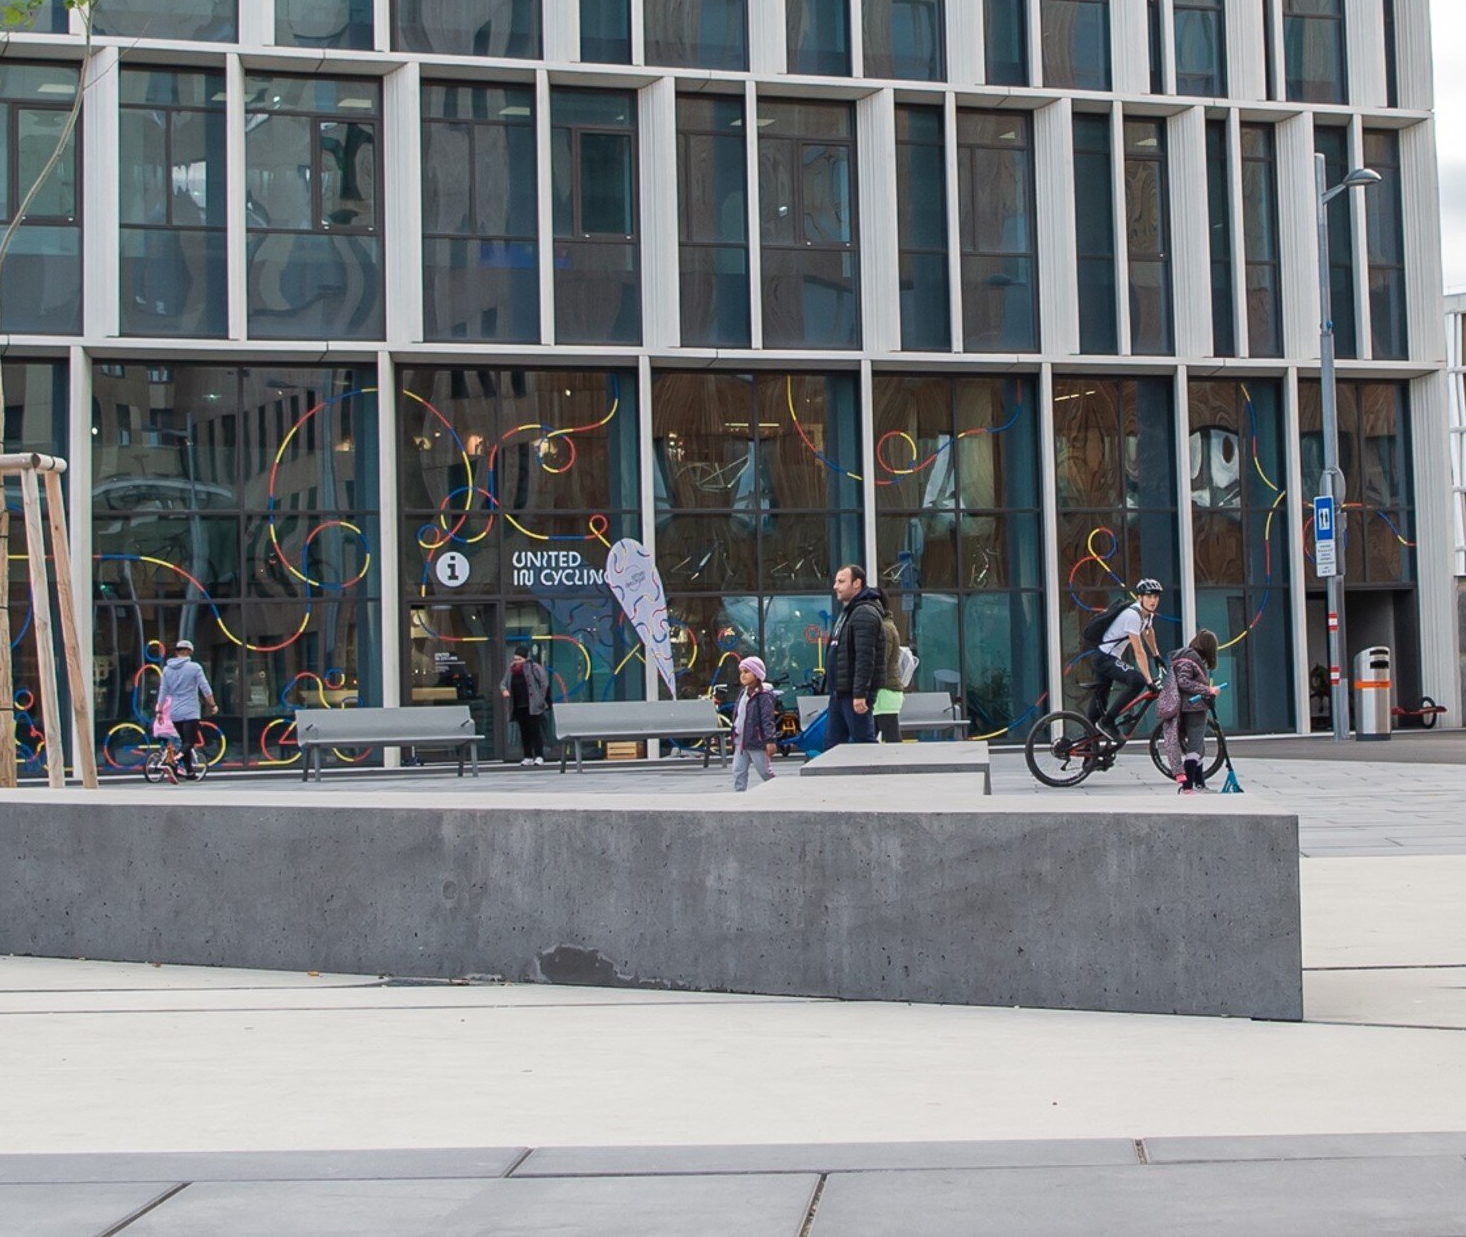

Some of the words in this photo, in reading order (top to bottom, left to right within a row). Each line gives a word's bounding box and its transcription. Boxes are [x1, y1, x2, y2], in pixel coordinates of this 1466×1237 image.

[512, 550, 582, 568] UNITED
[513, 569, 534, 586] IN
[540, 568, 609, 586] CYCLIN
